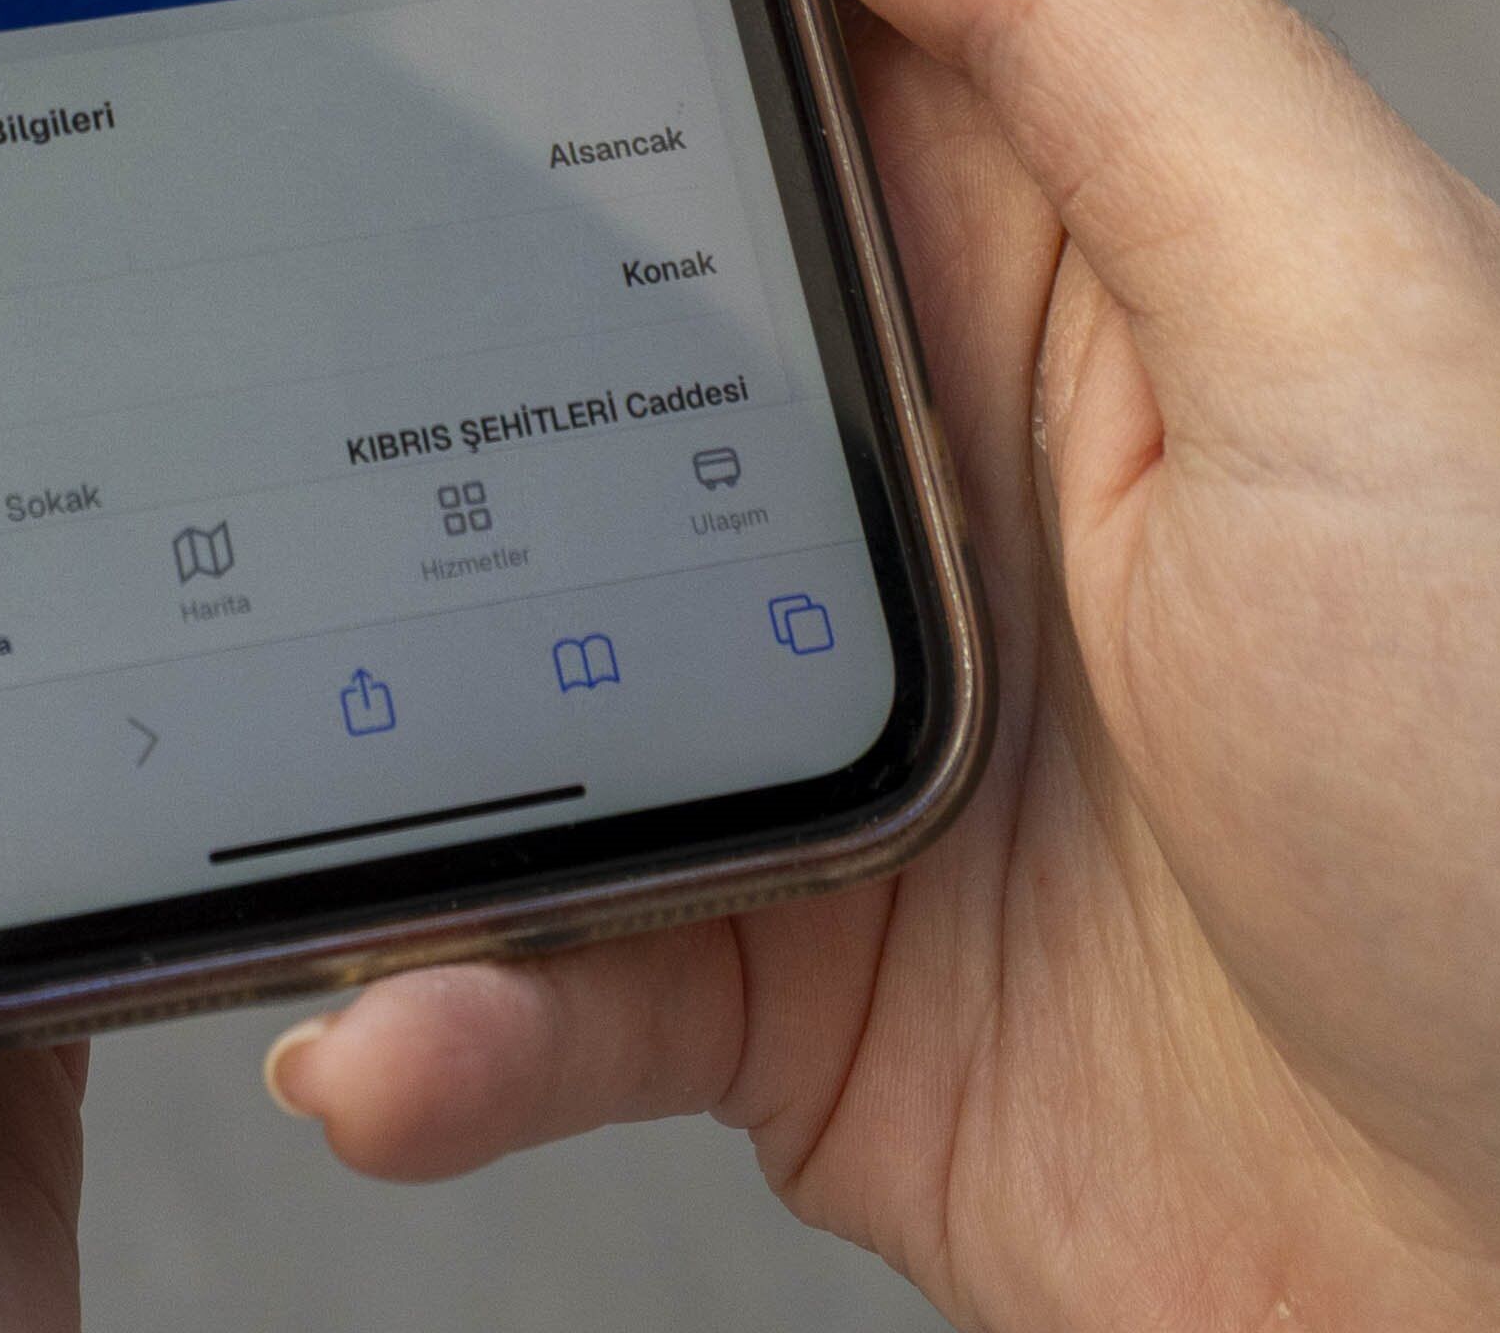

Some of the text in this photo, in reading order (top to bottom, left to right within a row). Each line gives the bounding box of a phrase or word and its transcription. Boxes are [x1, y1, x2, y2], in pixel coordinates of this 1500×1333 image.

[549, 126, 687, 169] Alsancak
[622, 251, 717, 287] Konak
[347, 375, 749, 465] KIBRIS ŞEHİTLERİ Caddesi
[6, 483, 103, 523] Sokak
[690, 506, 769, 537] Ulaşım
[421, 546, 532, 581] Hizmetler
[180, 594, 252, 623] Harita
